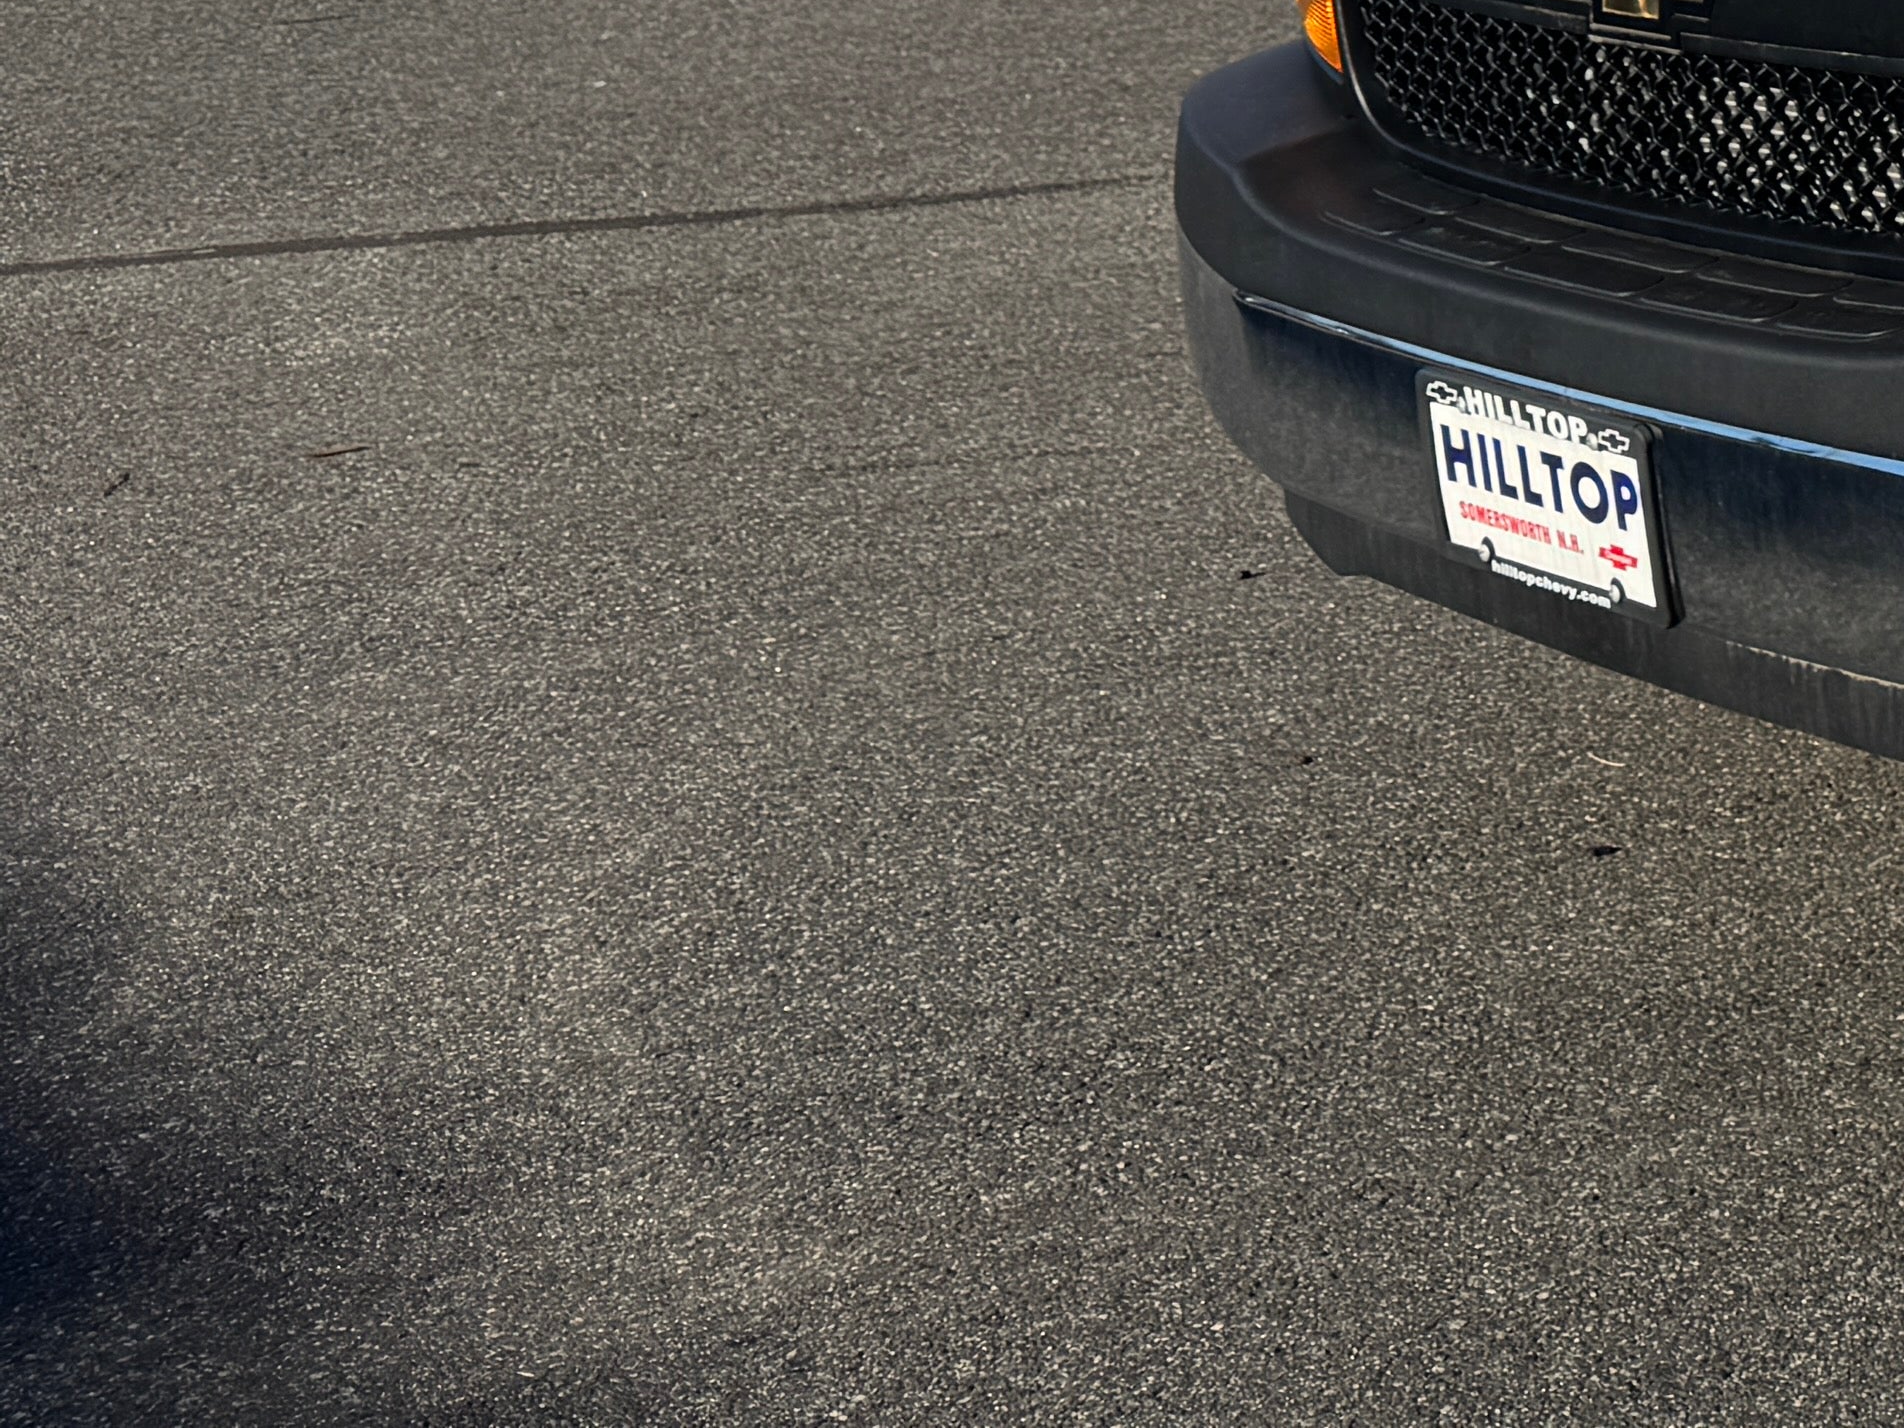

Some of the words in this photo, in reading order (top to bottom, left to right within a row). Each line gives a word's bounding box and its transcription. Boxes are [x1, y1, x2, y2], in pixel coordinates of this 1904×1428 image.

[1463, 386, 1588, 444] HILLTOP
[1440, 424, 1638, 532] HILLTOP
[1459, 500, 1552, 545] SOMERSWORTH
[1556, 529, 1585, 555] N.H.
[1491, 558, 1612, 609] hilltopchevy.com
